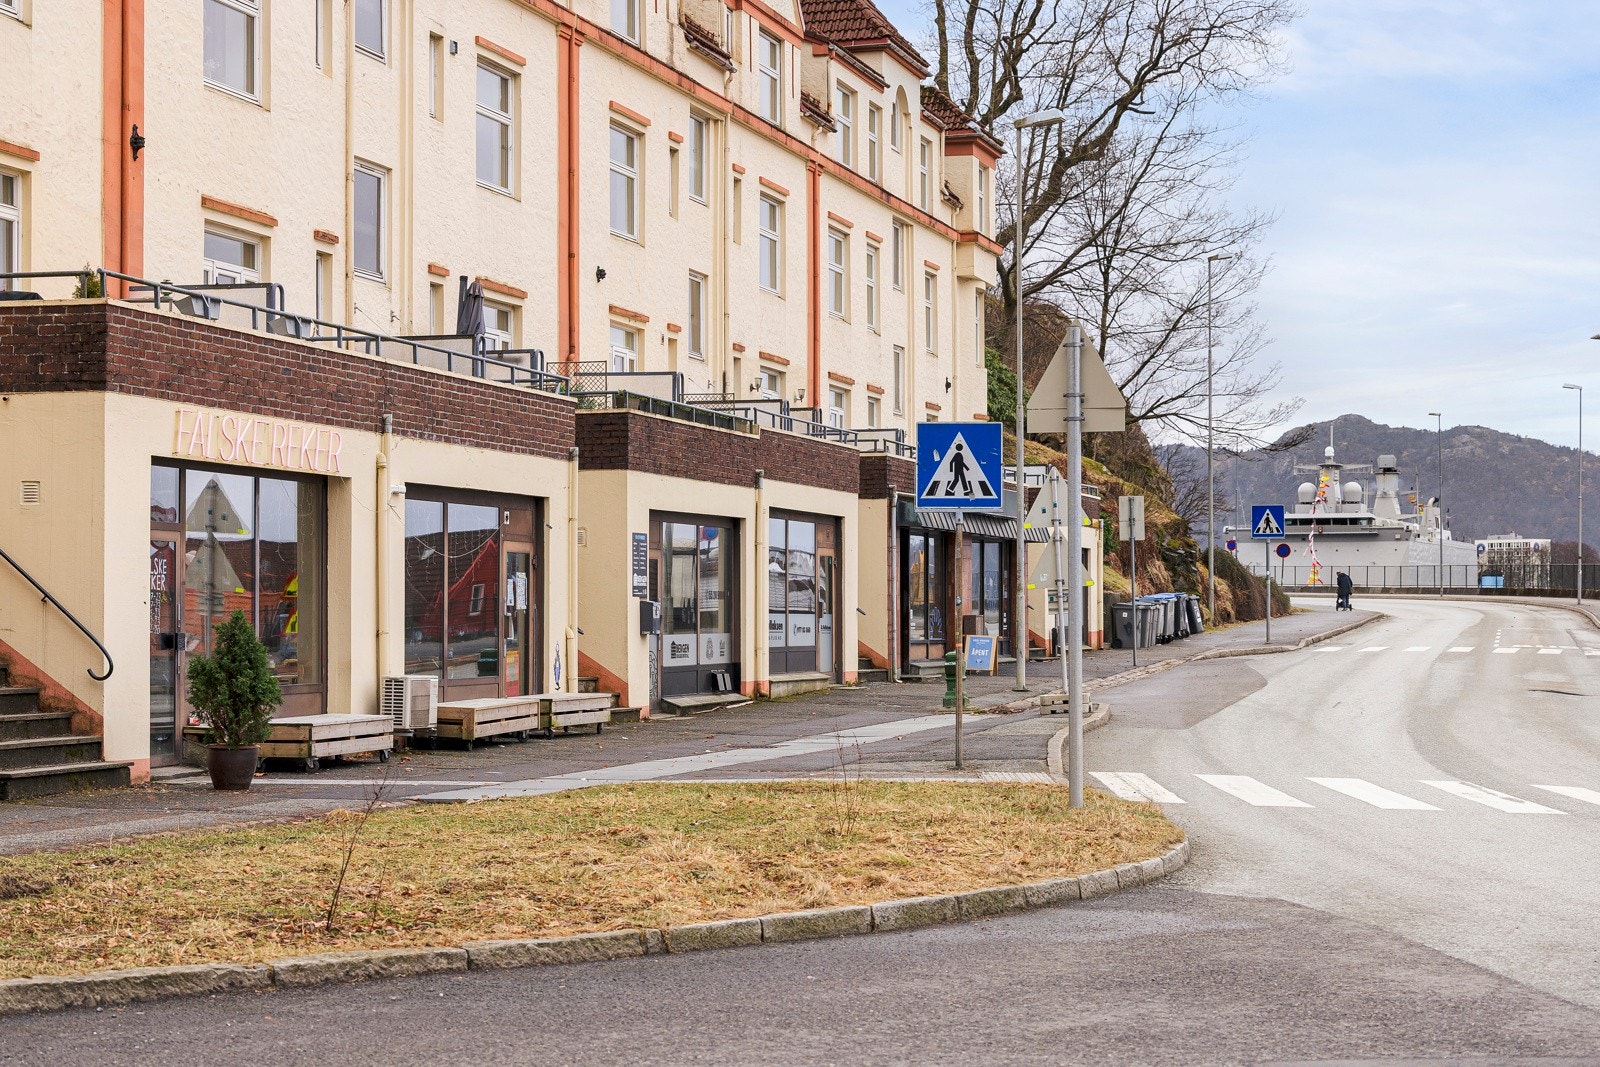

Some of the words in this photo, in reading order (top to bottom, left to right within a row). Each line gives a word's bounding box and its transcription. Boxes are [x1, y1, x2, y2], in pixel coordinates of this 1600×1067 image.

[177, 408, 268, 465] FALSKE
[271, 421, 343, 473] REKER
[150, 574, 166, 591] KER
[971, 647, 989, 657] ÅPENT
